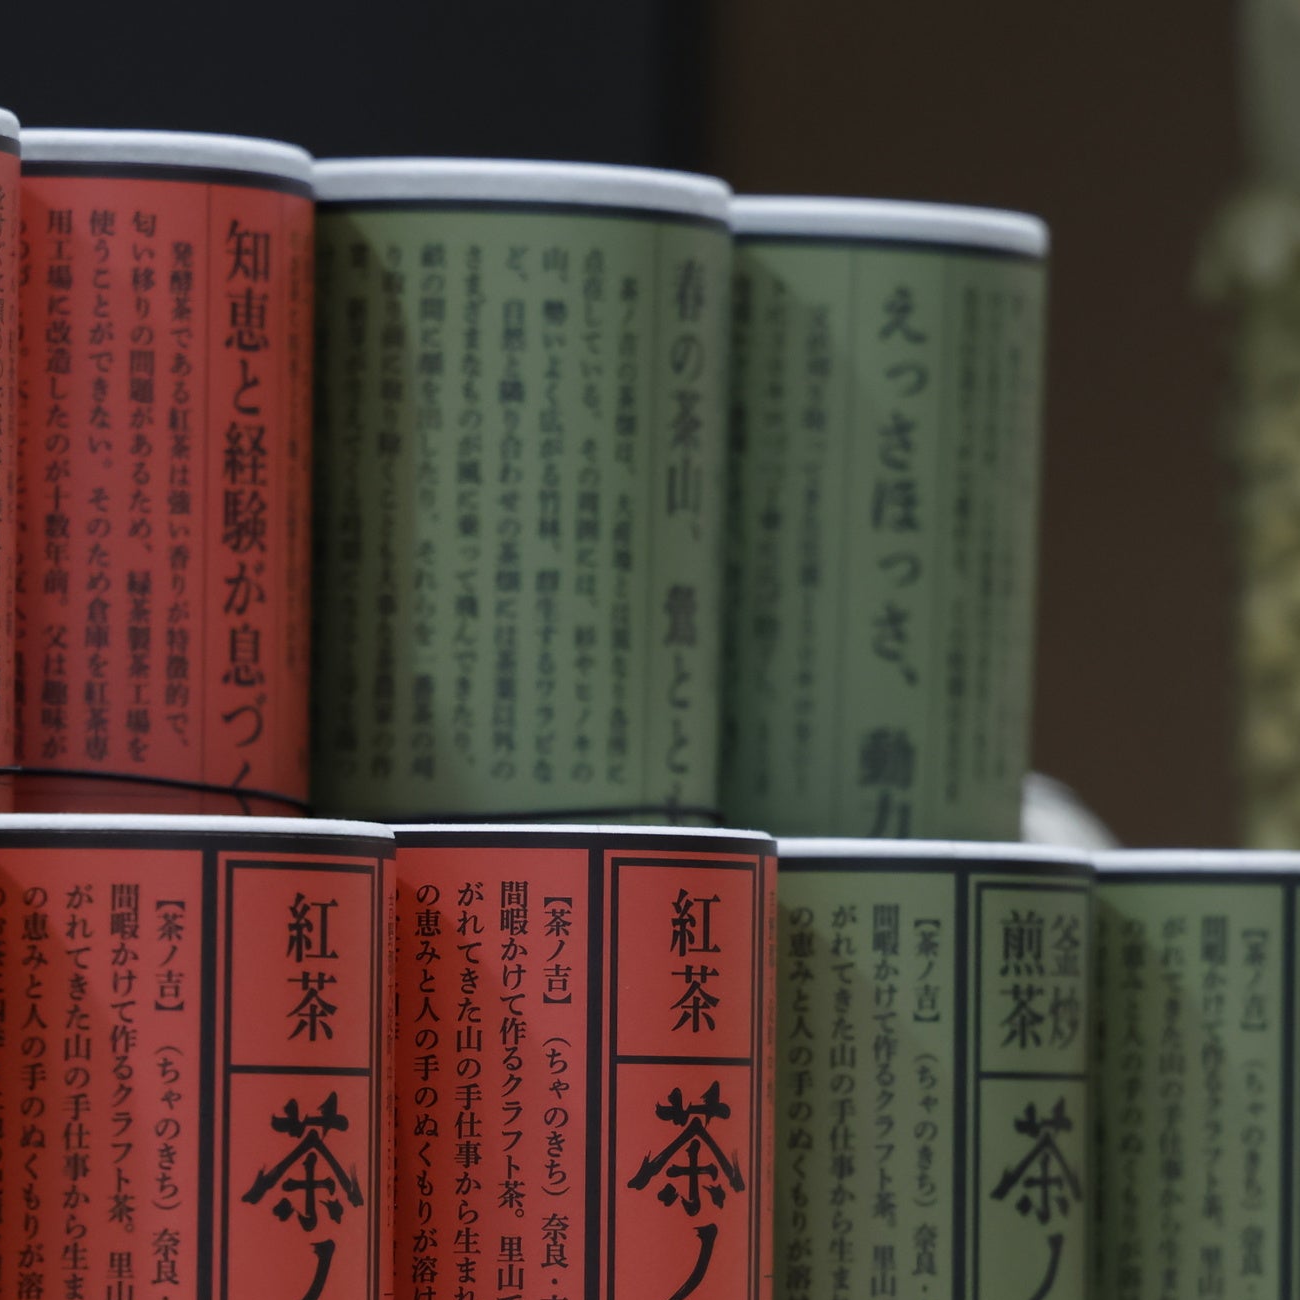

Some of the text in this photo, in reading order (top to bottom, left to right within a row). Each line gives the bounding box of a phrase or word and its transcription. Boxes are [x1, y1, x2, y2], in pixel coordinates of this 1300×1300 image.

[222, 218, 271, 815] 知恵と経験が息づく
[286, 893, 340, 1042] 紅茶
[670, 889, 721, 1034] 紅茶
[999, 909, 1045, 1049] 煎茶
